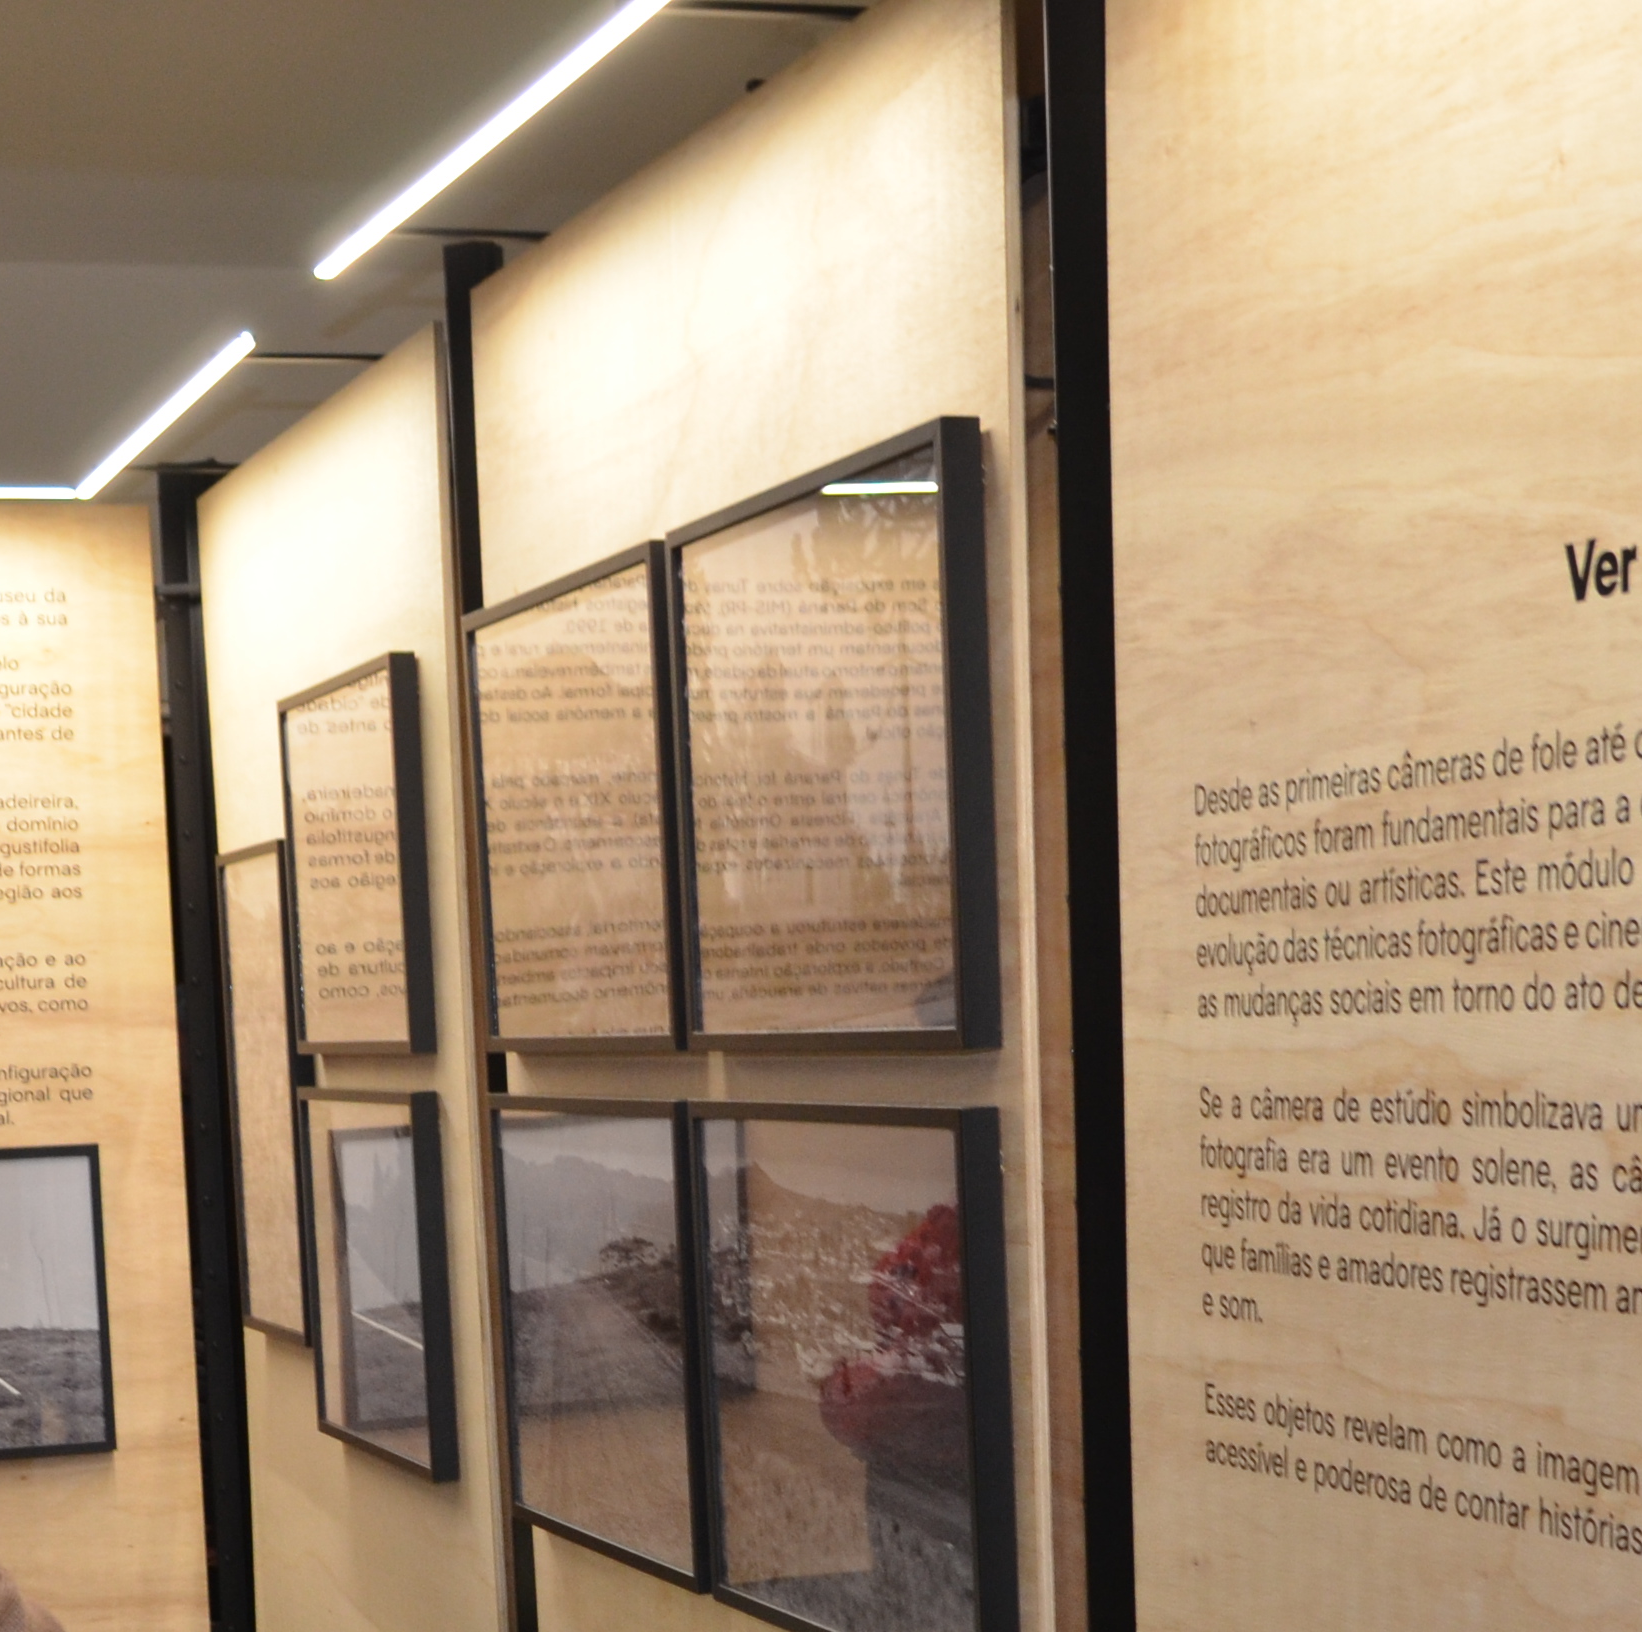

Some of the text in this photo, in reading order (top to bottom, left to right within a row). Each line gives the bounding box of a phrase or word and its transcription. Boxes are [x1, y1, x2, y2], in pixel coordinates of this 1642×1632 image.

[44, 588, 66, 603] da
[1564, 538, 1637, 603] Ver
[19, 612, 28, 626] à
[37, 614, 68, 626] sua
[1194, 778, 1253, 817] Desde
[1259, 781, 1280, 808] as
[1286, 766, 1381, 811] primeiras
[1387, 750, 1485, 791] câmeras
[1493, 737, 1523, 778] de
[1531, 730, 1578, 772] fole
[1586, 722, 1626, 766] até
[1195, 825, 1306, 872] fotográficos
[1313, 818, 1374, 854] foram
[1382, 798, 1539, 846] fundamentais
[1549, 797, 1605, 839] para
[1615, 794, 1630, 824] a
[1199, 1085, 1222, 1119] Se
[1231, 1094, 1242, 1119] a
[1251, 1087, 1323, 1122] câmera
[1334, 1087, 1360, 1123] de
[1370, 1088, 1451, 1127] estúdio
[1462, 1089, 1603, 1131] simbolizava
[1201, 1191, 1270, 1228] registro
[1278, 1191, 1302, 1225] da
[1309, 1193, 1351, 1229] vida
[1359, 1199, 1466, 1240] cotidiana.
[1473, 1205, 1501, 1242] Já
[1511, 1216, 1526, 1244] o
[1205, 1382, 1256, 1422] Esses
[1264, 1394, 1335, 1438] objetos
[1344, 1414, 1427, 1454] revelam
[1437, 1432, 1502, 1469] como
[1512, 1445, 1526, 1473] a
[1537, 1442, 1639, 1497] imagem
[1205, 1439, 1288, 1478] acessível
[1295, 1458, 1307, 1483] e
[1314, 1459, 1411, 1505] poderosa
[1419, 1475, 1447, 1513] de
[1455, 1490, 1530, 1529] contar
